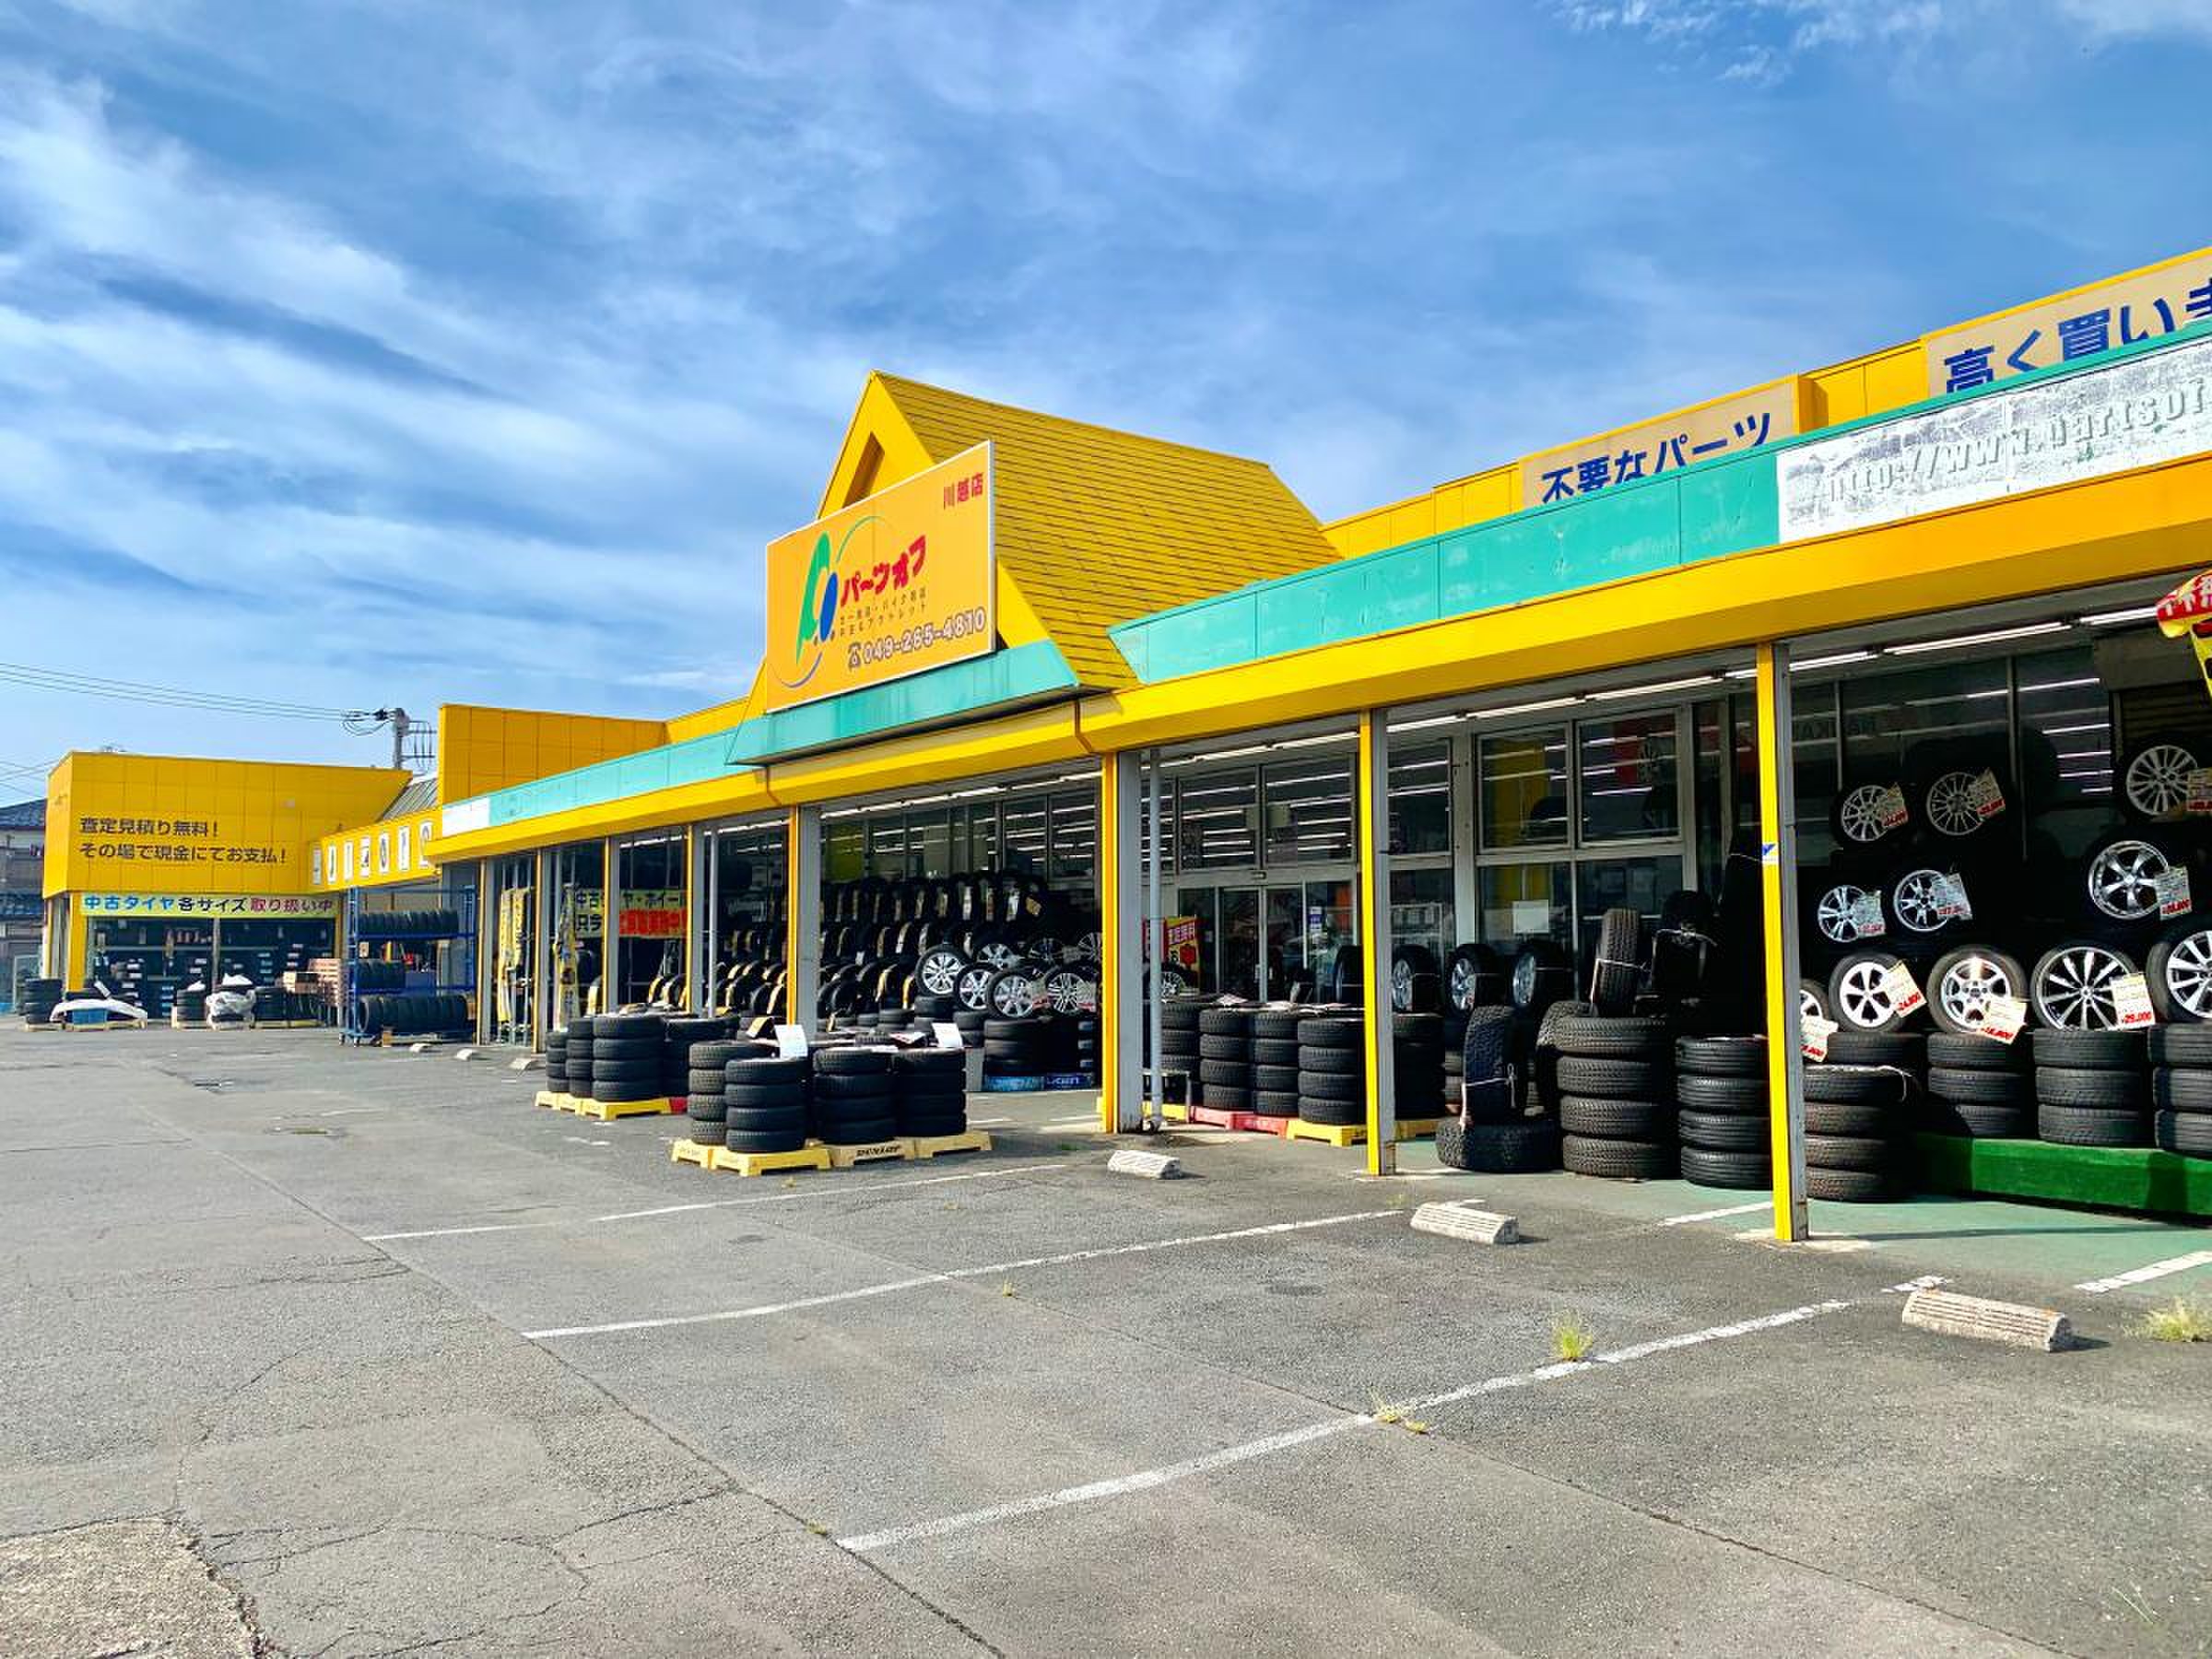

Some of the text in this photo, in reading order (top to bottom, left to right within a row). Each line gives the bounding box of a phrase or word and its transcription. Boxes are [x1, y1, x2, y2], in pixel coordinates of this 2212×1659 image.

[1541, 411, 1771, 505] 不要なパーツ
[943, 471, 984, 510] 川越店
[80, 817, 218, 838] 査定見積り無料！
